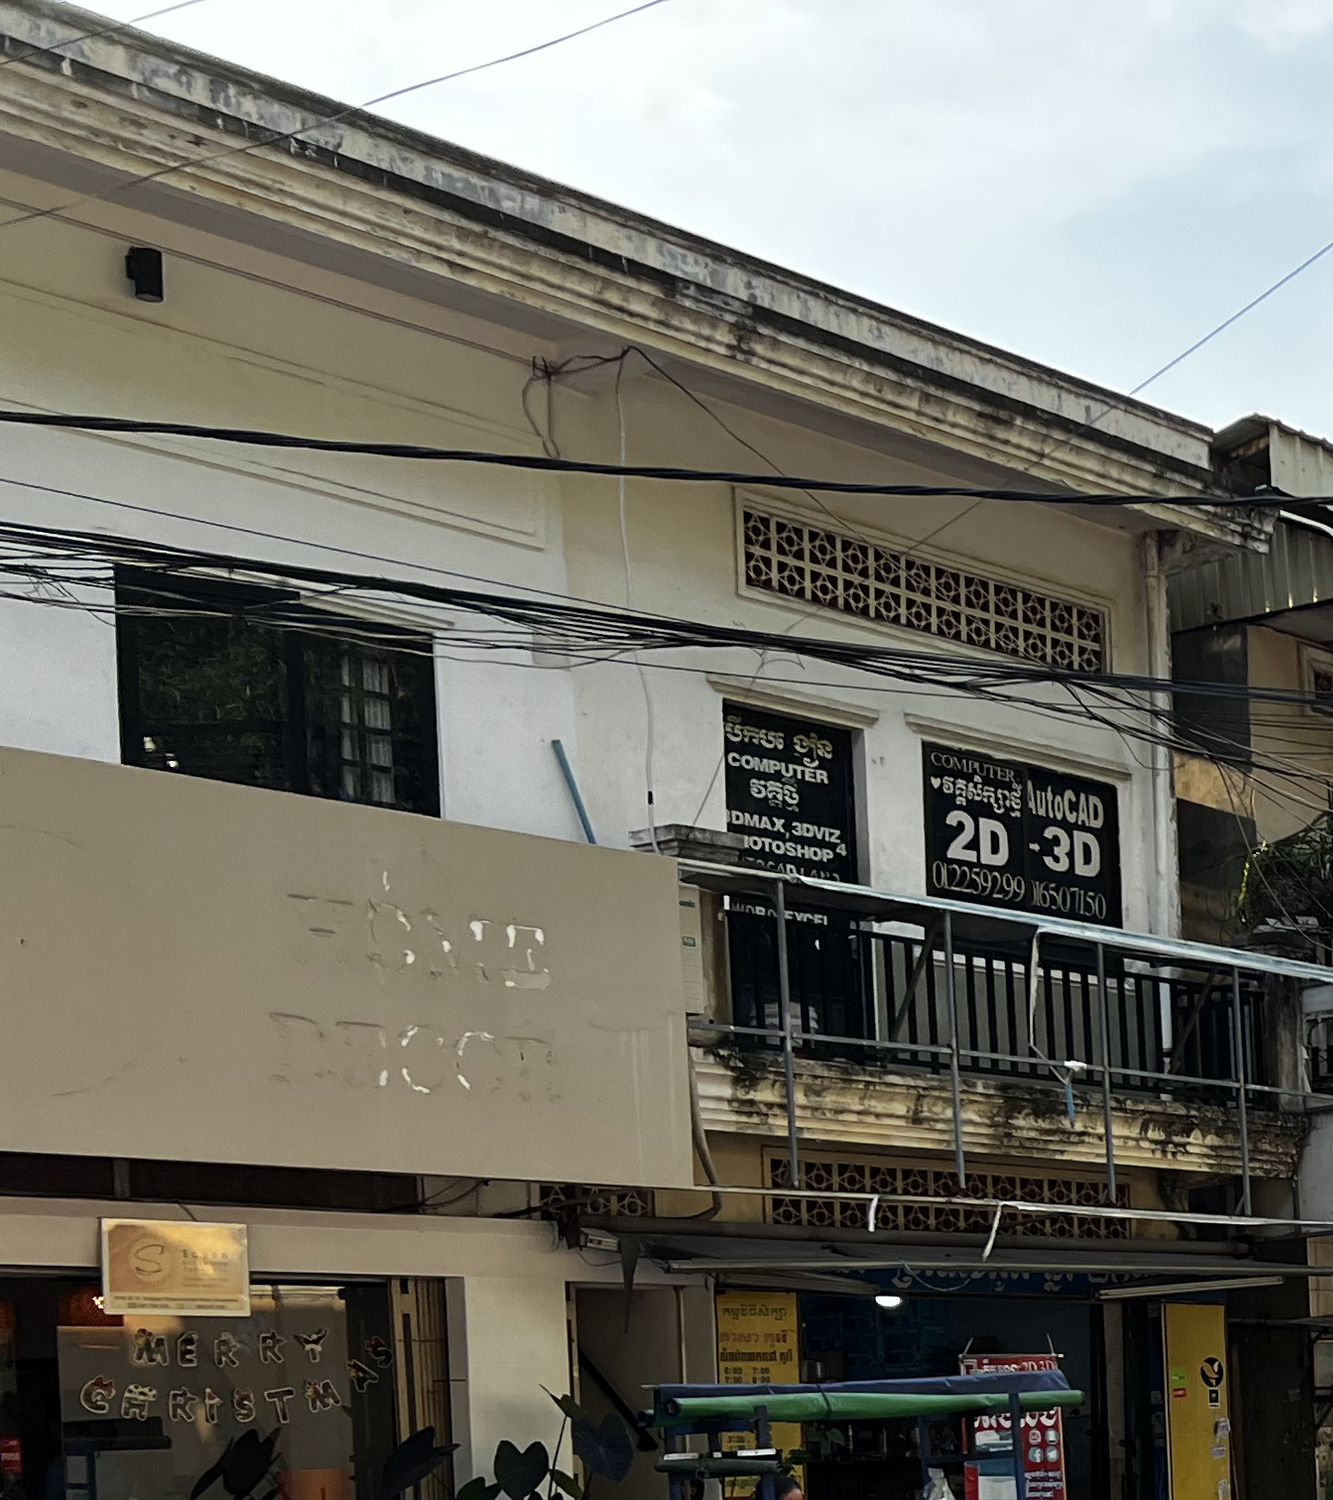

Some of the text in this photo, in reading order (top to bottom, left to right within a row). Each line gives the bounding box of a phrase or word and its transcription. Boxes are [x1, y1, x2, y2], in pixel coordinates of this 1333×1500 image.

[727, 752, 829, 785] COMPUTER
[930, 752, 1015, 782] COMPUTER
[1027, 780, 1104, 828] AutoCAD
[945, 810, 1101, 878] 2D 3D
[932, 860, 1025, 902] 012259299
[132, 1328, 329, 1369] MERRY
[80, 1335, 393, 1424] CHRISTMAS
